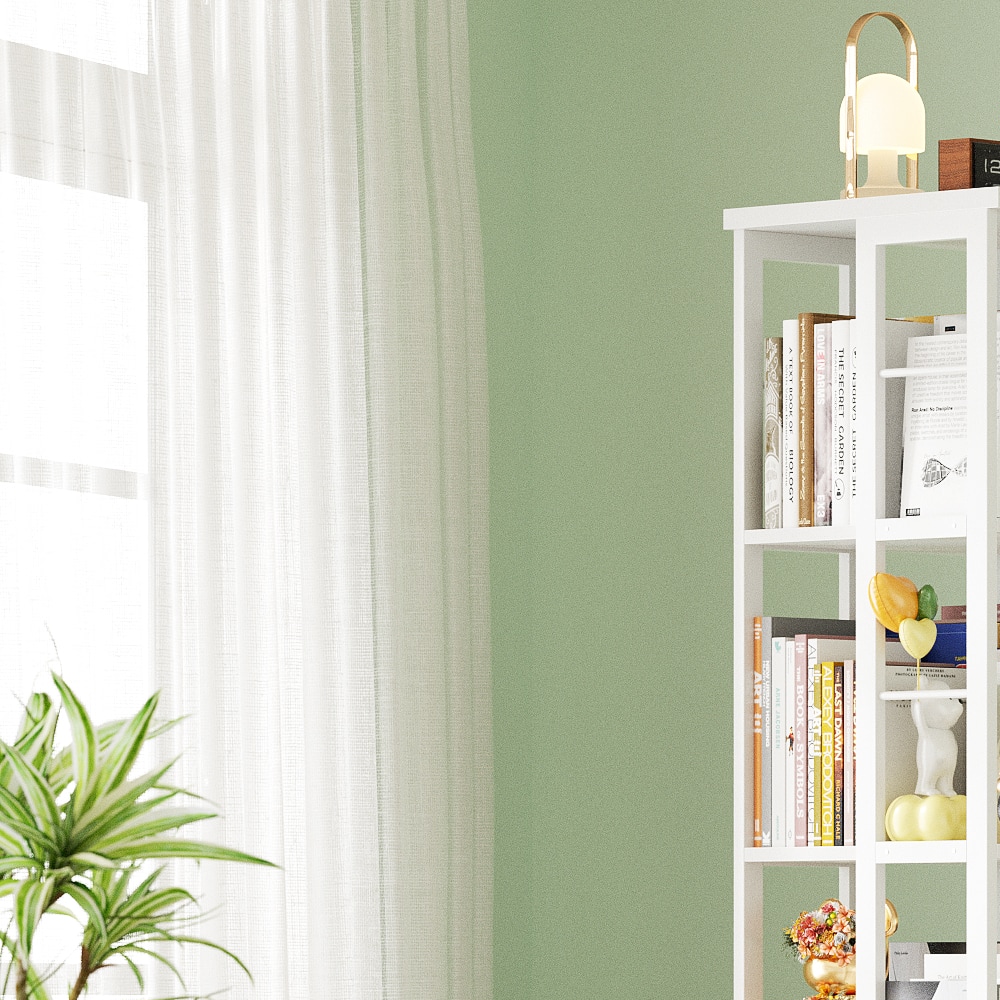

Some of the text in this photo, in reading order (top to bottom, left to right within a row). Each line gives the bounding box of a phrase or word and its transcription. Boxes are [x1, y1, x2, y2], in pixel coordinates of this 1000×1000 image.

[817, 328, 825, 405] LOVE IN ARMS
[788, 421, 794, 434] OF
[754, 671, 762, 707] ART
[796, 685, 805, 728] BOOK
[834, 683, 842, 716] LAST
[813, 706, 822, 736] ART
[834, 717, 842, 761] DAWN
[822, 665, 833, 836] ALEXEY BRODOVITCH
[796, 743, 804, 819] SYMBOLS
